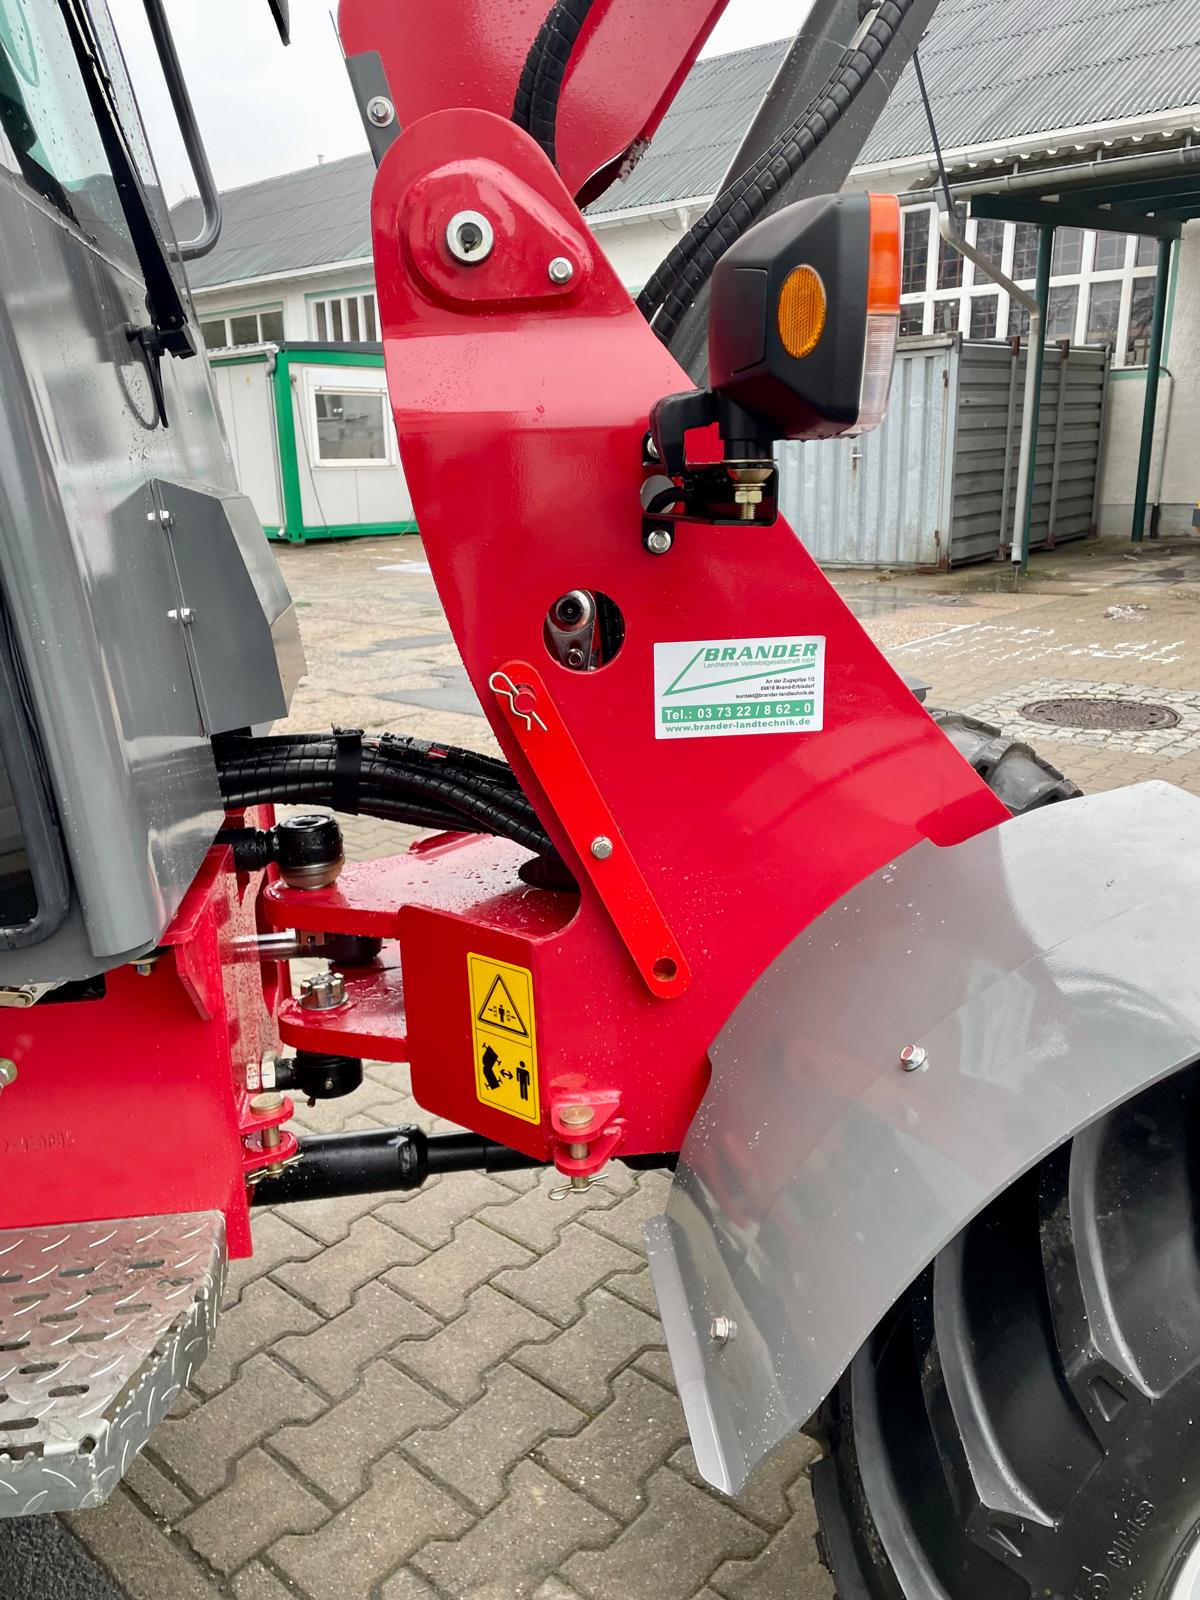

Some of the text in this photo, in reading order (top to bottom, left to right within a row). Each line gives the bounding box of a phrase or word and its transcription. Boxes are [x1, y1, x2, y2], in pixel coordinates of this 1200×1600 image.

[704, 643, 818, 662] BRANDER
[704, 656, 817, 669] Landtechnik Vertriebsgesellschaft mbH
[783, 677, 807, 685] Zugspitze
[736, 690, 815, 699] kontakt@brander-landtechnik.de
[665, 709, 692, 721] Tel.:
[697, 708, 712, 719] 03
[717, 707, 732, 718] 73
[736, 706, 751, 717] 22
[755, 705, 760, 716] /
[764, 704, 771, 715] 8
[775, 703, 790, 714] 62
[804, 702, 811, 714] 0
[665, 718, 811, 733] www.brander-landtechnik.de
